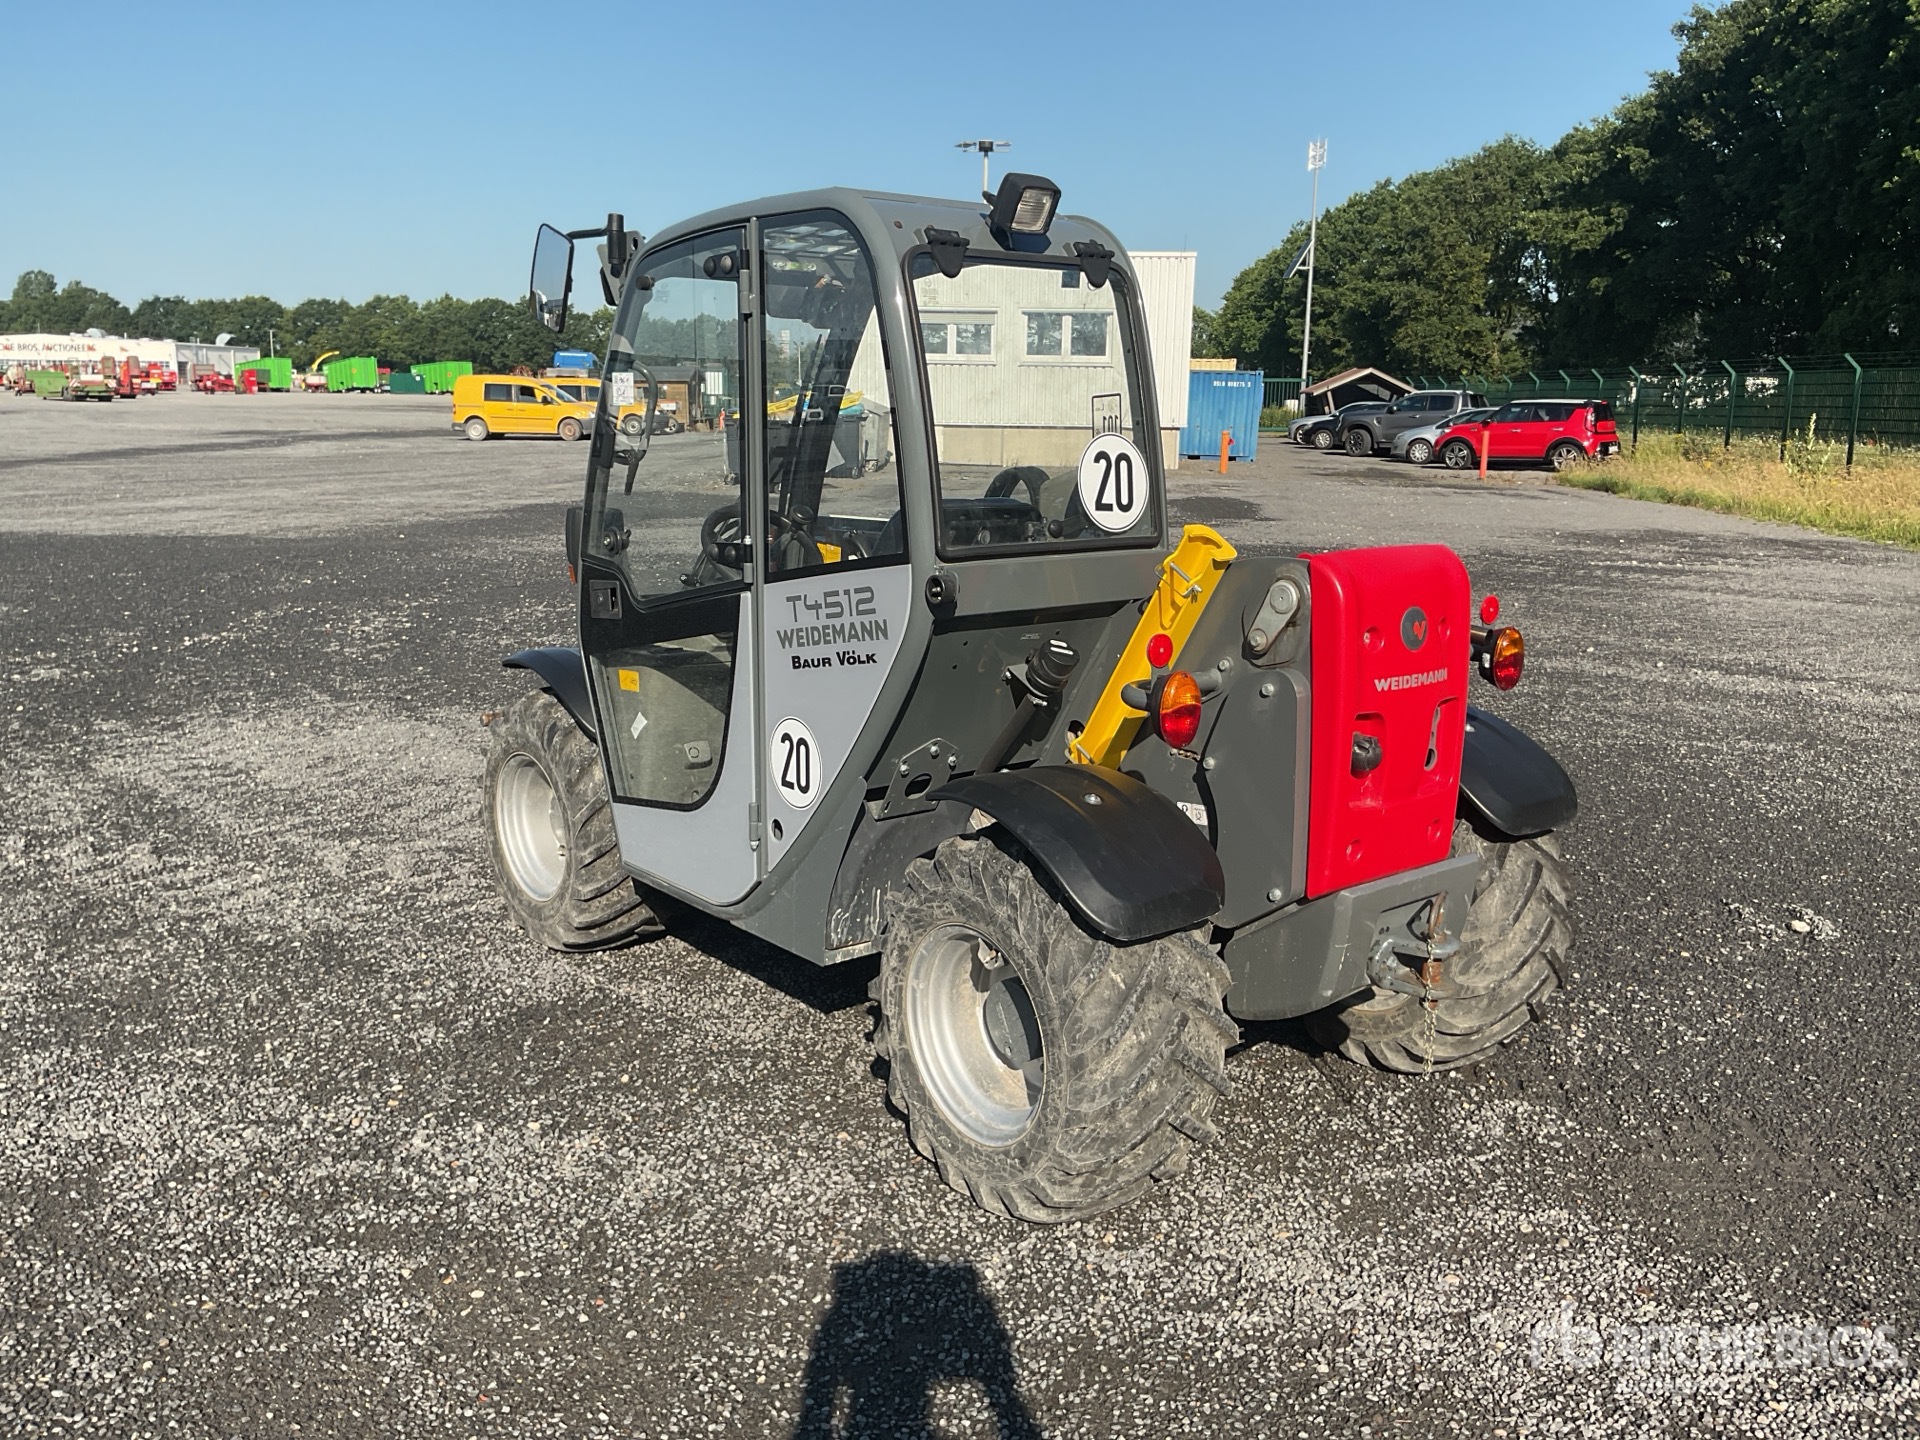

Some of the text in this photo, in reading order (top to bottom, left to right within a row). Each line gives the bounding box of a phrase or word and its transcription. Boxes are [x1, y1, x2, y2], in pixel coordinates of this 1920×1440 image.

[1093, 450, 1134, 513] 20
[786, 586, 877, 622] T4512
[776, 619, 889, 649] WEIDEMANN
[1374, 667, 1448, 692] WEIDEMANN
[780, 732, 810, 794] 20
